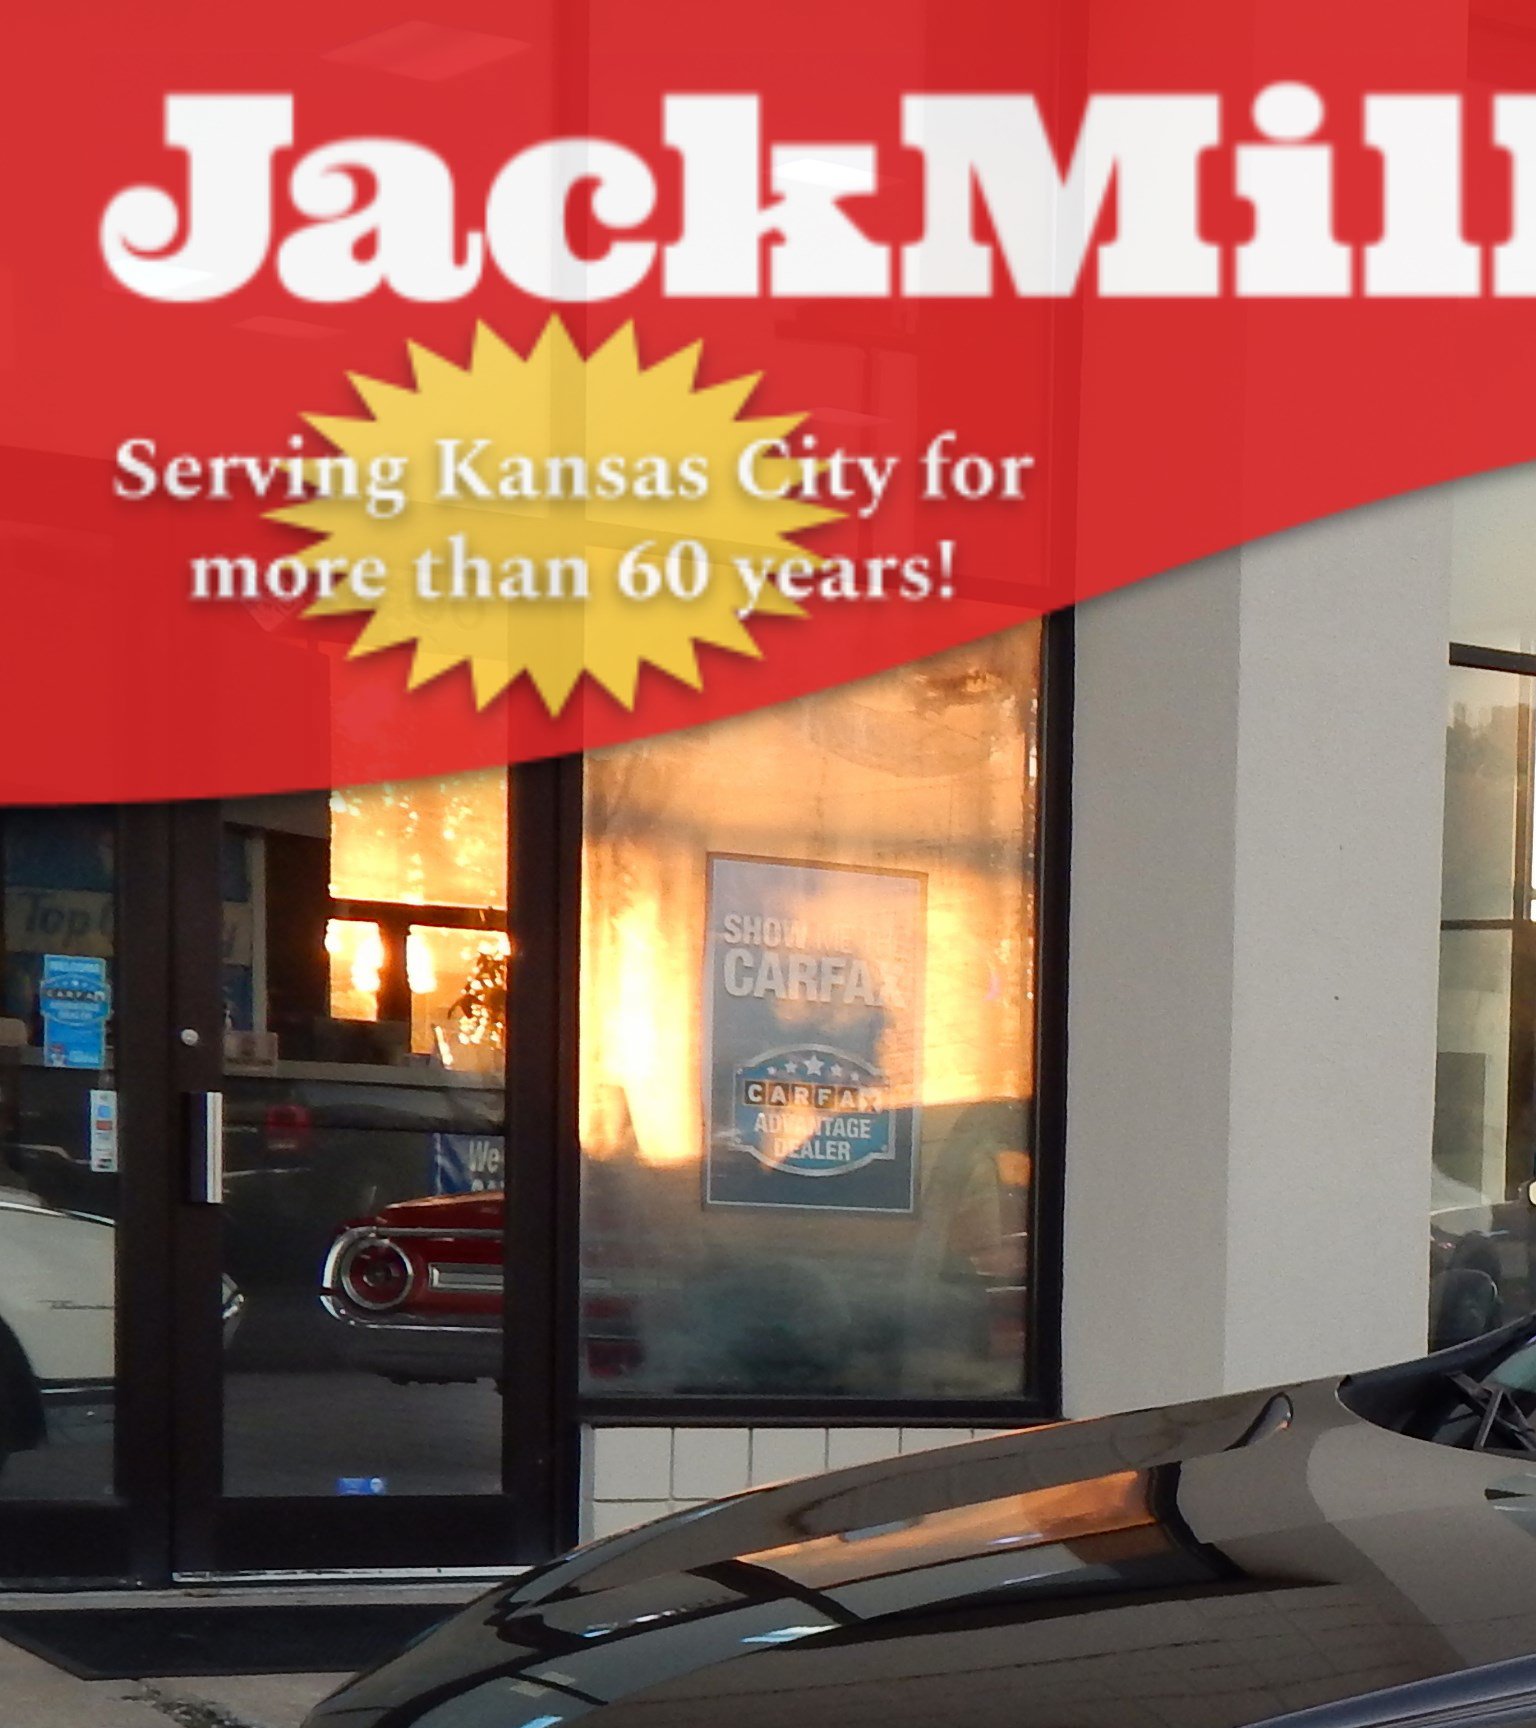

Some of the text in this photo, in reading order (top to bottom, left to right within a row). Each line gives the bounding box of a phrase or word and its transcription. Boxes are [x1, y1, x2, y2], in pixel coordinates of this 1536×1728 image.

[723, 912, 807, 949] SHOW
[723, 947, 907, 1009] CARFAX
[747, 1082, 882, 1113] CARFAX
[753, 1111, 872, 1140] ADNTAGE
